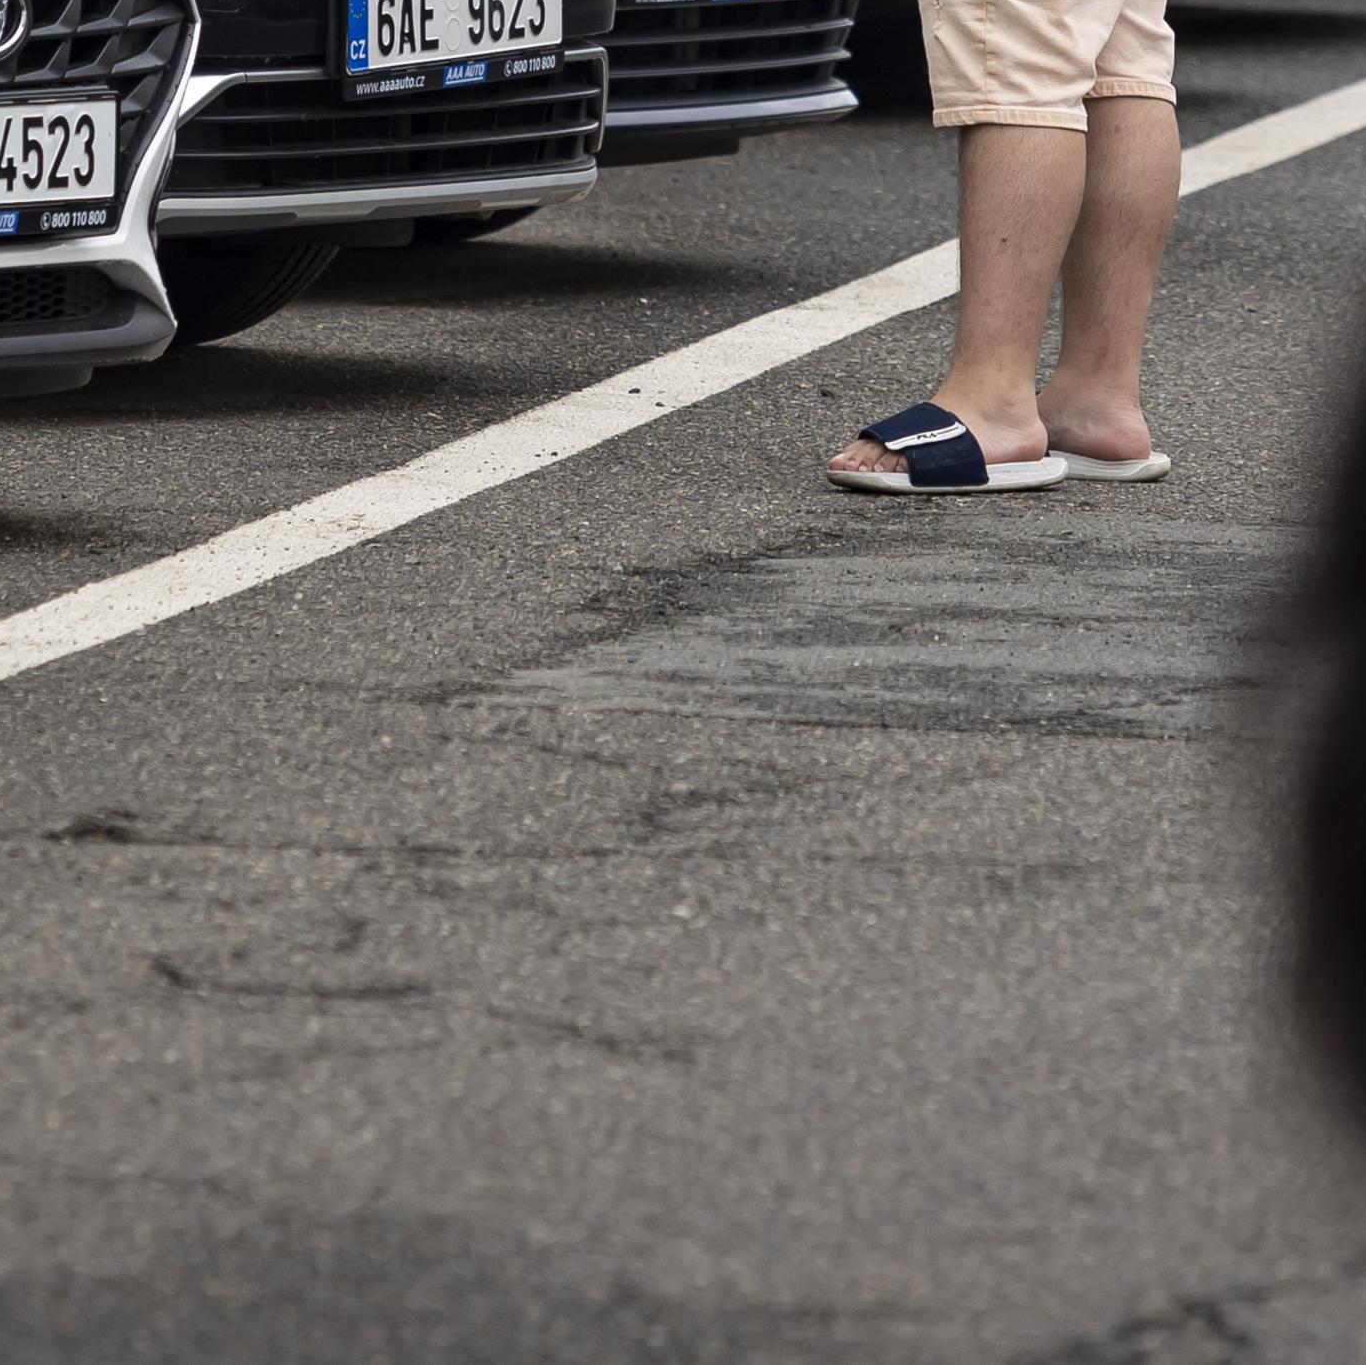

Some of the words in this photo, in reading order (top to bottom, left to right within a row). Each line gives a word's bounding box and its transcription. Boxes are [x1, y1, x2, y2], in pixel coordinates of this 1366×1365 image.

[350, 39, 366, 60] CZ
[446, 66, 463, 82] AAA
[464, 63, 485, 79] AUTO
[512, 59, 528, 74] 800
[529, 57, 541, 72] 110
[541, 55, 556, 71] 800
[356, 76, 425, 95] www.aaaauto.cz
[51, 213, 70, 228] 800
[71, 211, 86, 226] 110
[87, 210, 107, 225] 800
